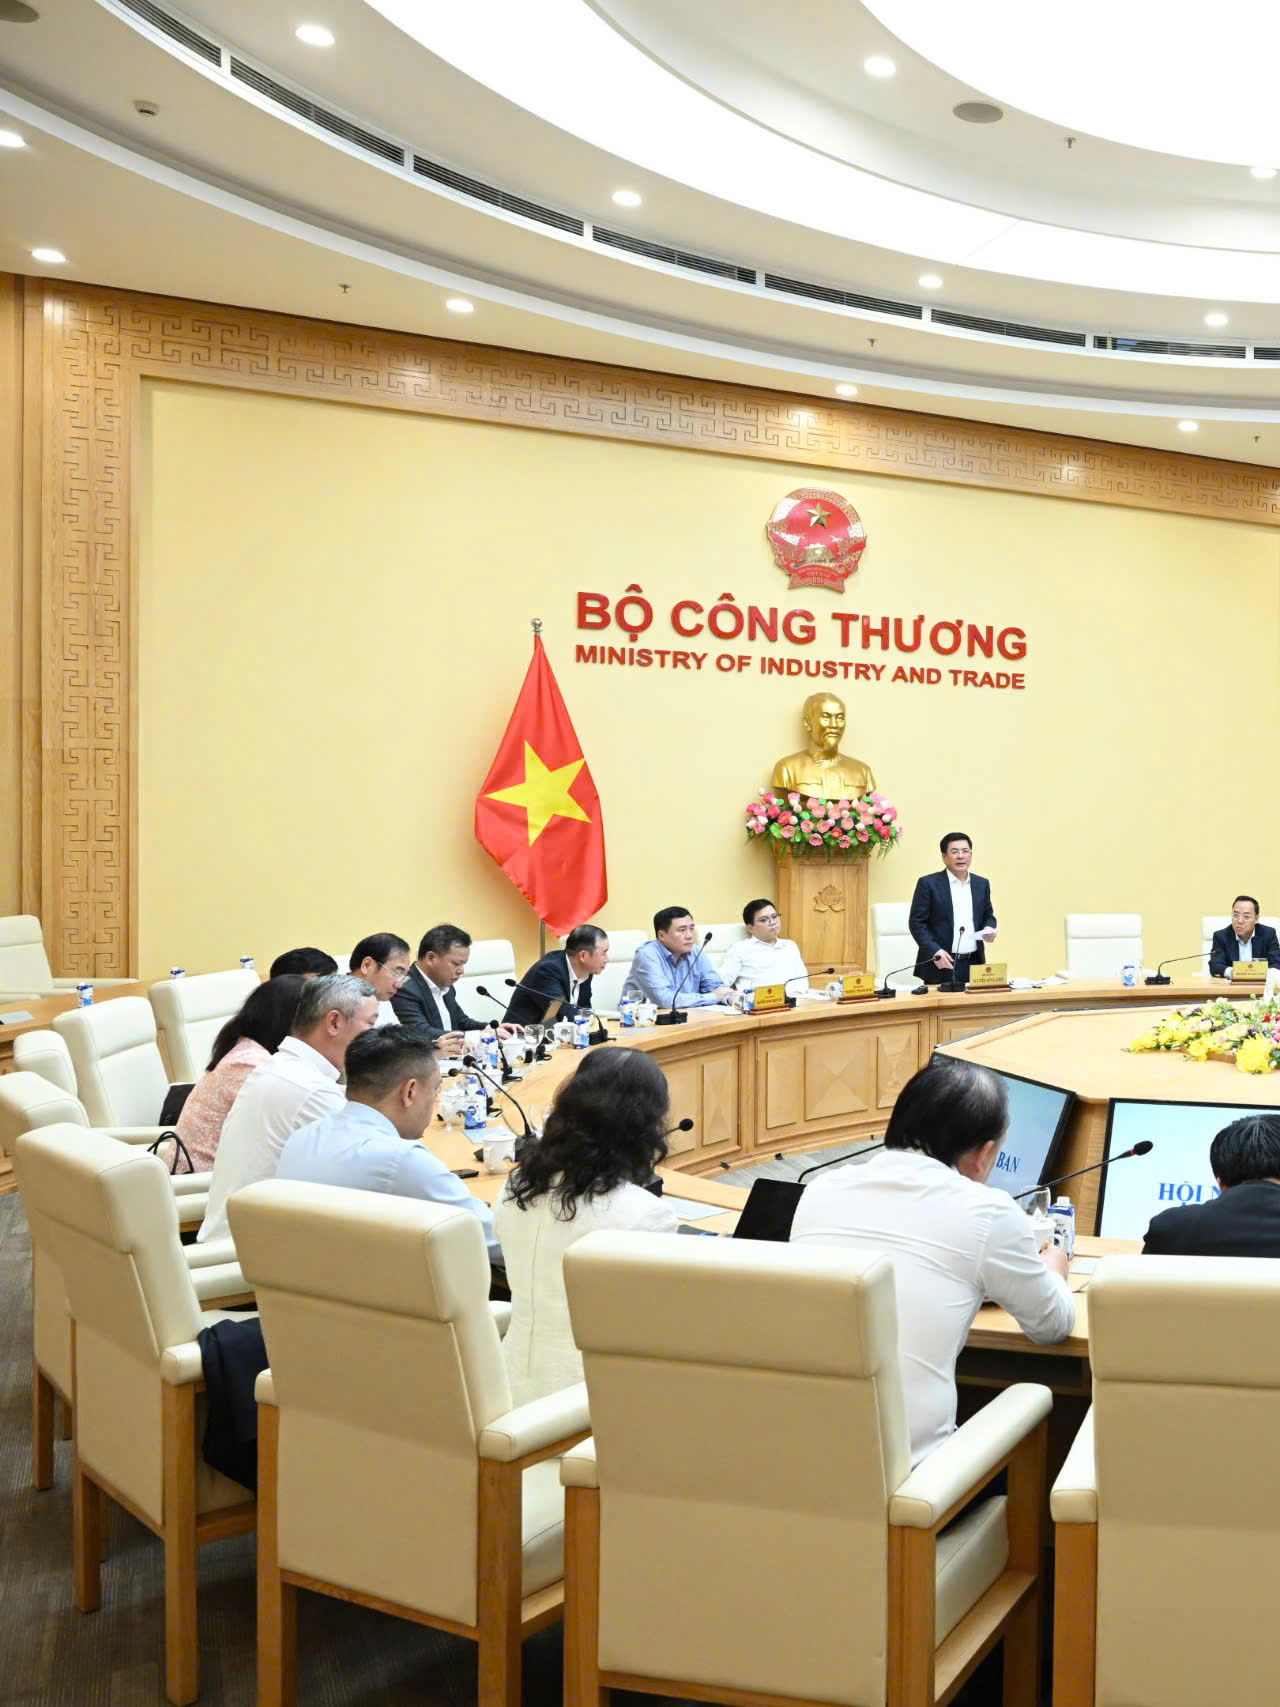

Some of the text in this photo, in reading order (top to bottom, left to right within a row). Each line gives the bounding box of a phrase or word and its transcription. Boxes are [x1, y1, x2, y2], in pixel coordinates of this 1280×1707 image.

[576, 584, 1027, 661] BỘ CÔNG THƯƠNG
[575, 645, 1026, 690] MINISTRY OF INDUSTRY AND TRADE
[996, 1151, 1020, 1174] BAN
[1159, 1181, 1202, 1206] HỘI
